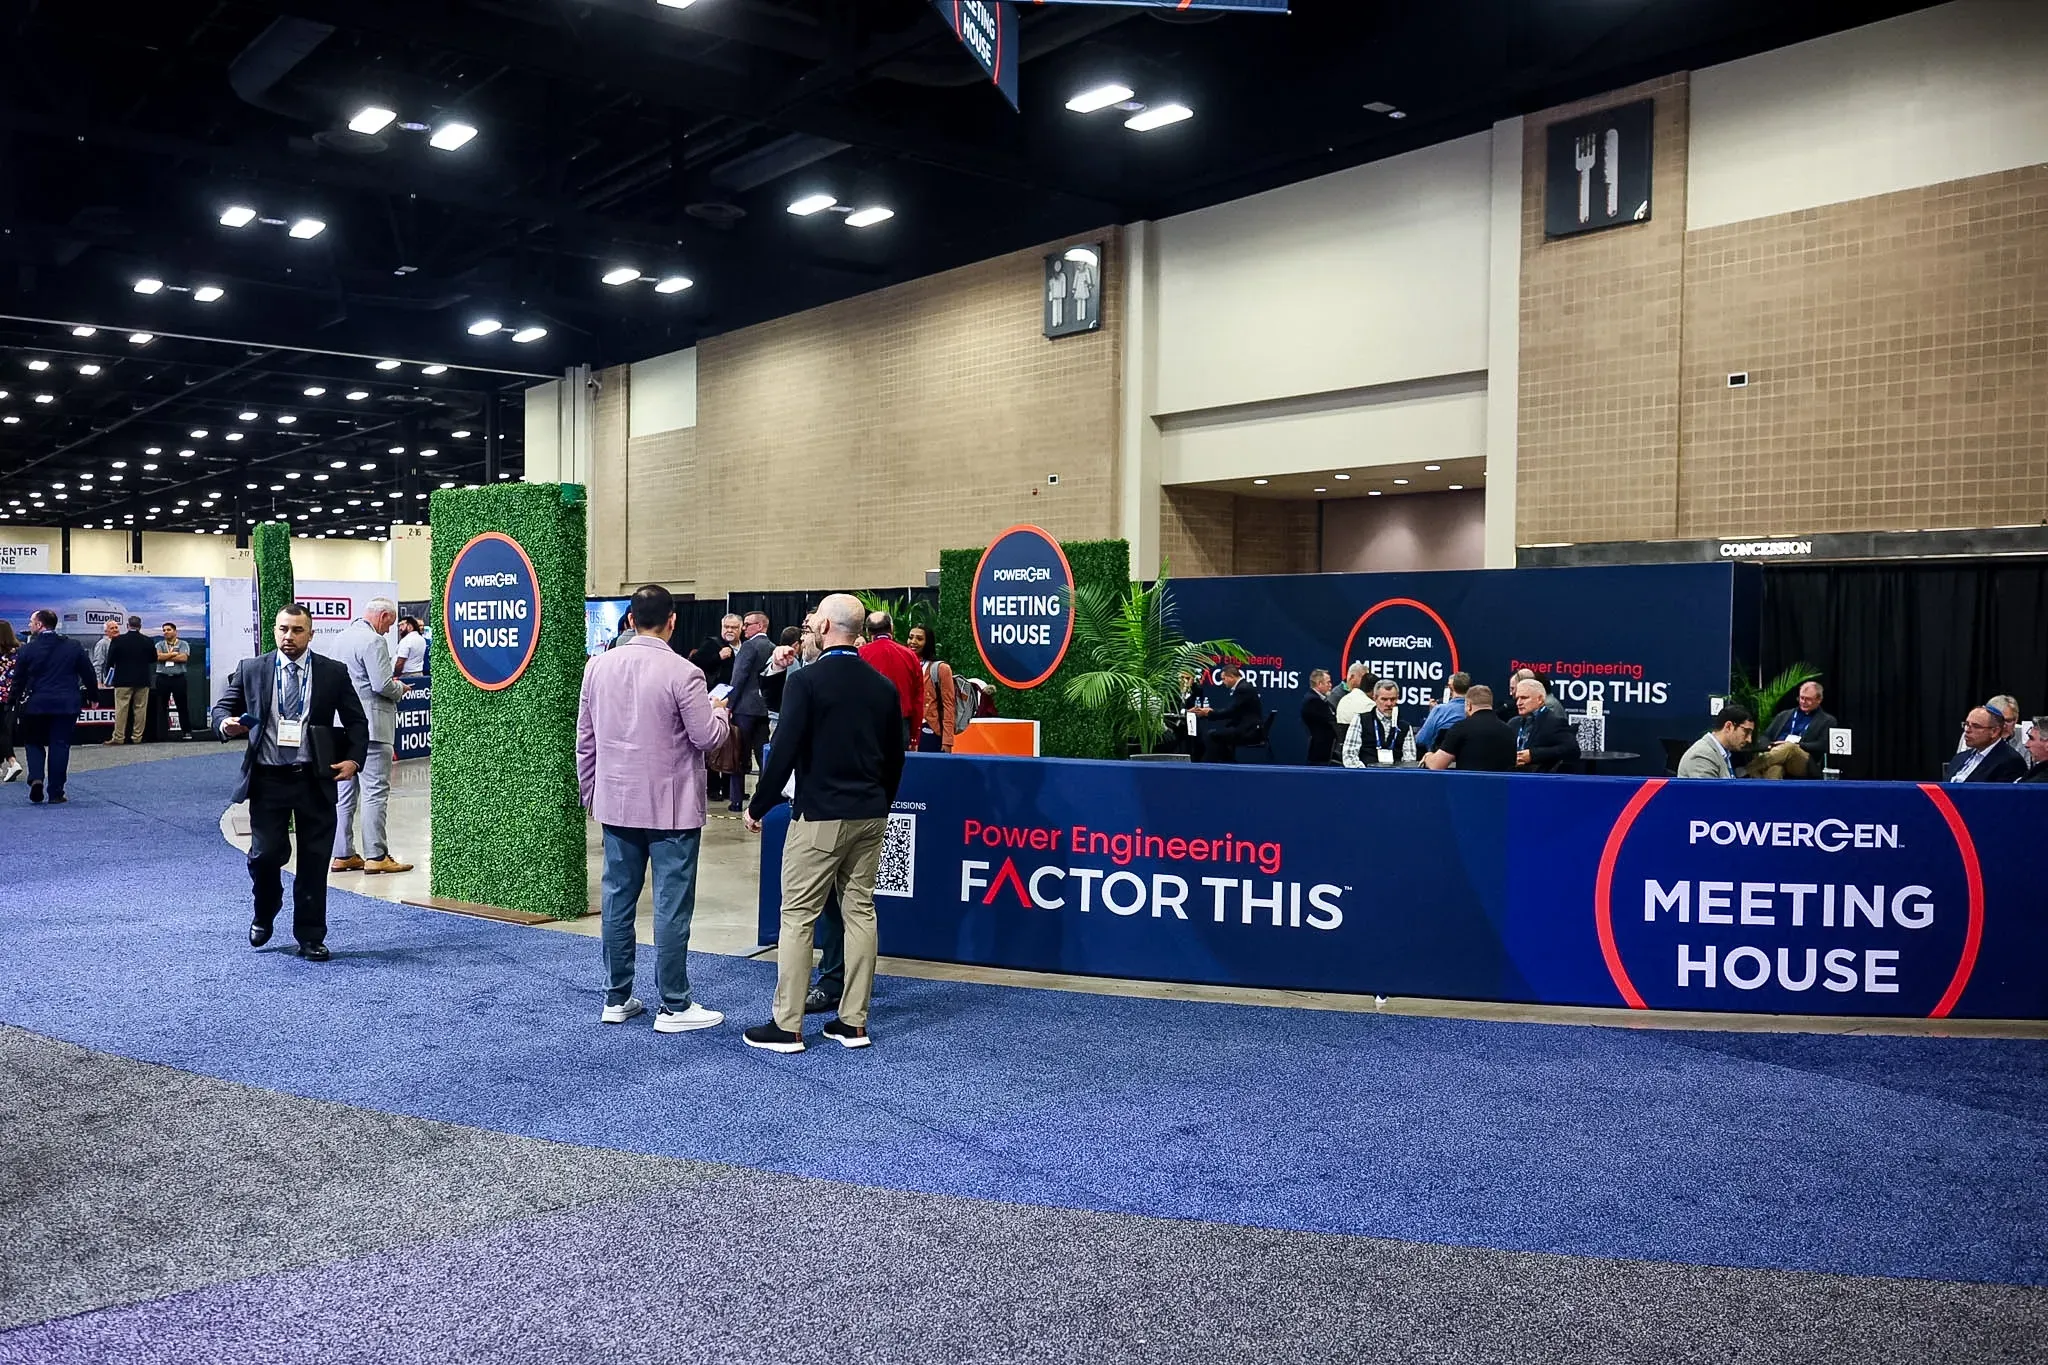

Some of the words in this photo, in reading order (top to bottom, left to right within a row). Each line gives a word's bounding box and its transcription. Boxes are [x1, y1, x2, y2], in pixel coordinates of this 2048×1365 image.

[963, 12, 991, 66] HOUSE
[1720, 541, 1812, 556] CONCESSION
[0, 556, 16, 565] NE
[464, 571, 517, 587] POWERGEN
[994, 567, 1050, 582] POWERGEN
[299, 602, 346, 615] LLER
[454, 600, 527, 621] MEETING
[982, 595, 1060, 616] MEETING
[463, 628, 518, 648] HOUSE
[991, 624, 1050, 645] HOUSE
[1368, 635, 1431, 649] POWERGEN
[1355, 660, 1443, 680] EETING
[1556, 661, 1642, 679] Engineering
[1397, 686, 1432, 705] USE
[395, 709, 432, 728] MEETI
[1590, 705, 1599, 714] 5
[1835, 735, 1845, 748] 3
[963, 819, 1063, 850] Power
[1072, 825, 1282, 875] Engineering
[960, 855, 1190, 920] FACTOR
[1644, 879, 1935, 930] MEETING
[1677, 944, 1900, 993] HOUSE
